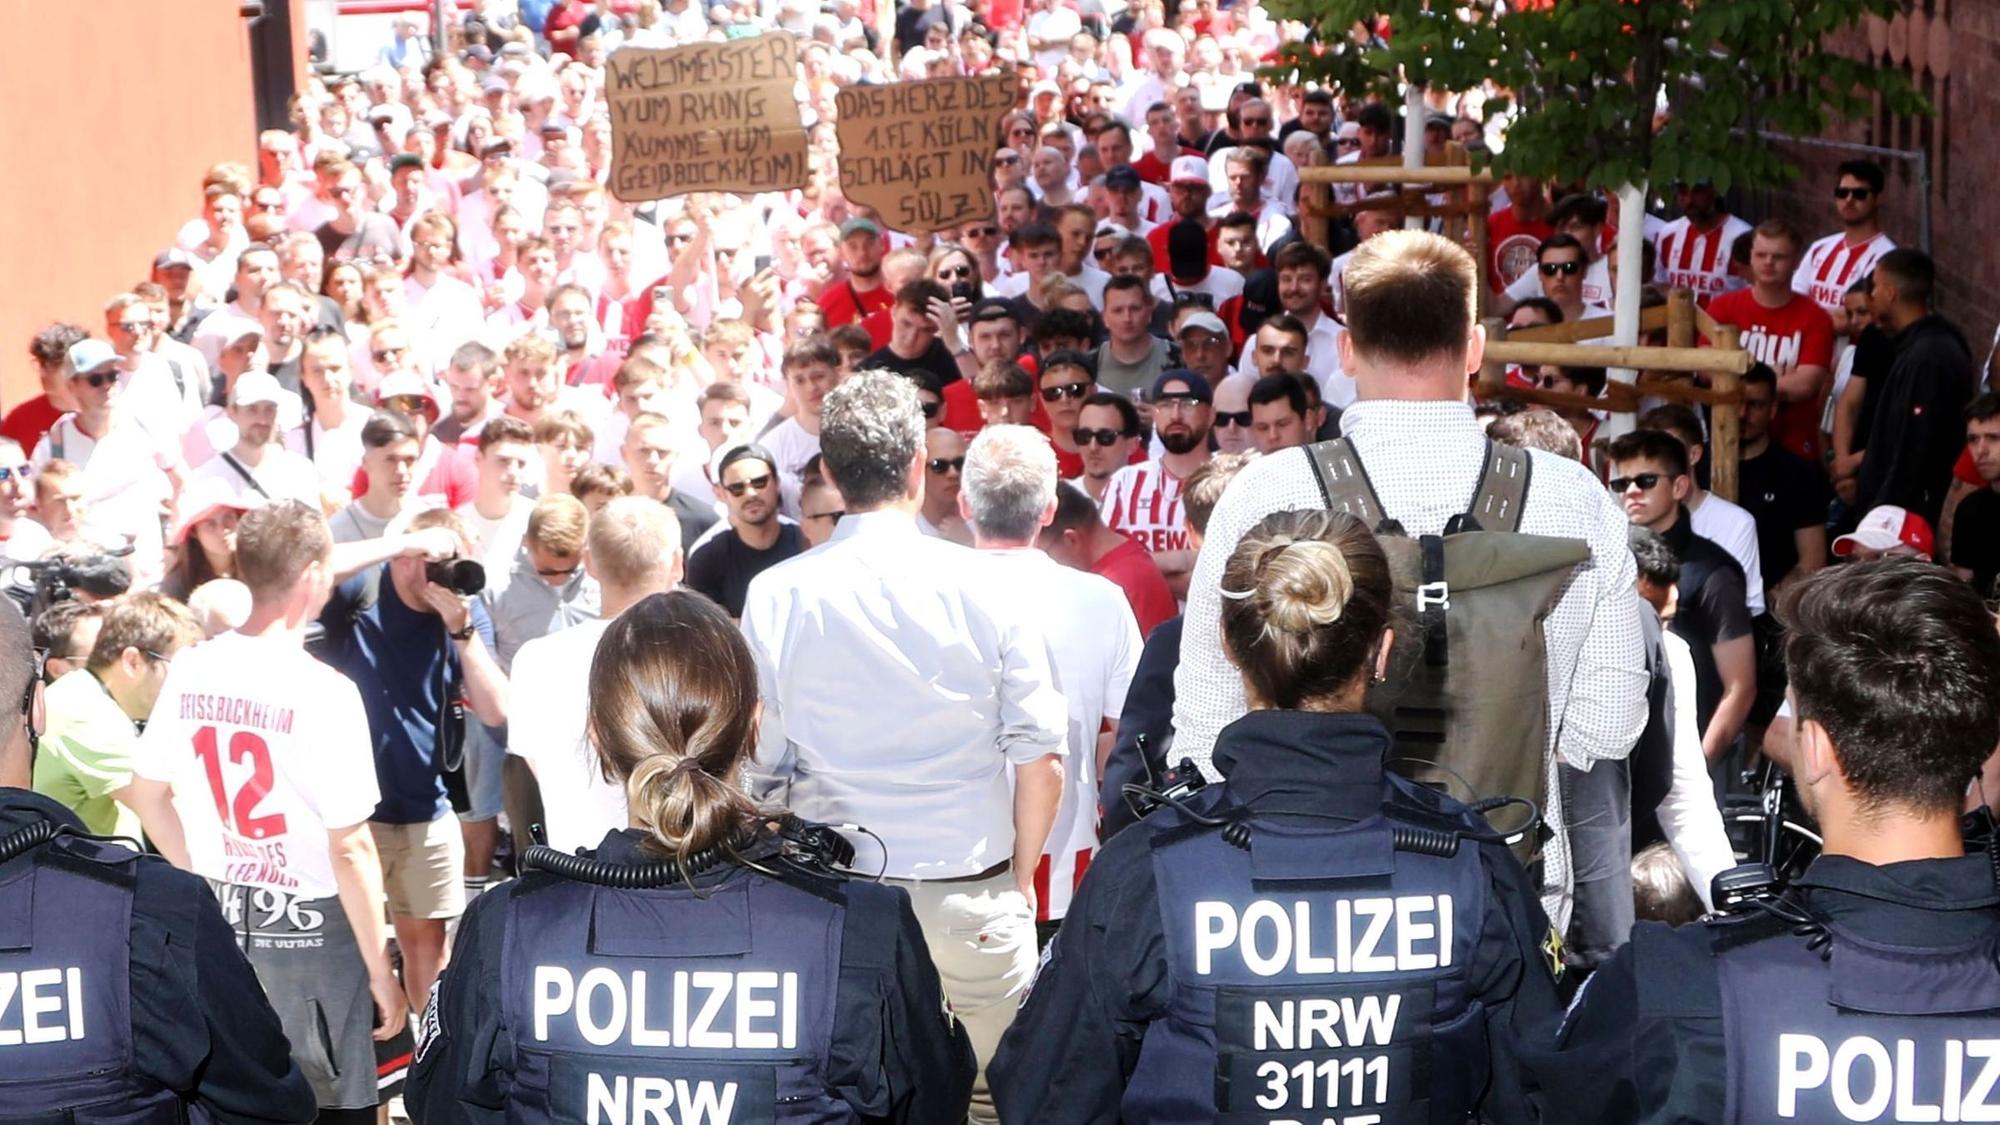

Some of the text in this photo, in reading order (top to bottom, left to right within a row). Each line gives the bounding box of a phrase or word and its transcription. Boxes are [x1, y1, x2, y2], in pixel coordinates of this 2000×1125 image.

[611, 37, 794, 90] WELTMEISTER
[680, 86, 767, 125] RHING
[840, 77, 1015, 120] DAS HERZ DES
[621, 130, 709, 162] KUMME
[922, 114, 989, 148] KÖLN
[841, 147, 989, 189] SCHLÄGT IN
[900, 187, 989, 226] SÜLZ!
[1132, 529, 1191, 553] REW
[191, 725, 288, 840] 12
[252, 887, 325, 932] 96
[1194, 894, 1453, 977] POLIZEI
[534, 965, 798, 1049] POLIZEI
[1254, 994, 1401, 1051] NRW
[586, 1072, 738, 1125] NRW
[1255, 1055, 1389, 1110] 31111
[1777, 1033, 2000, 1123] POLIZ
